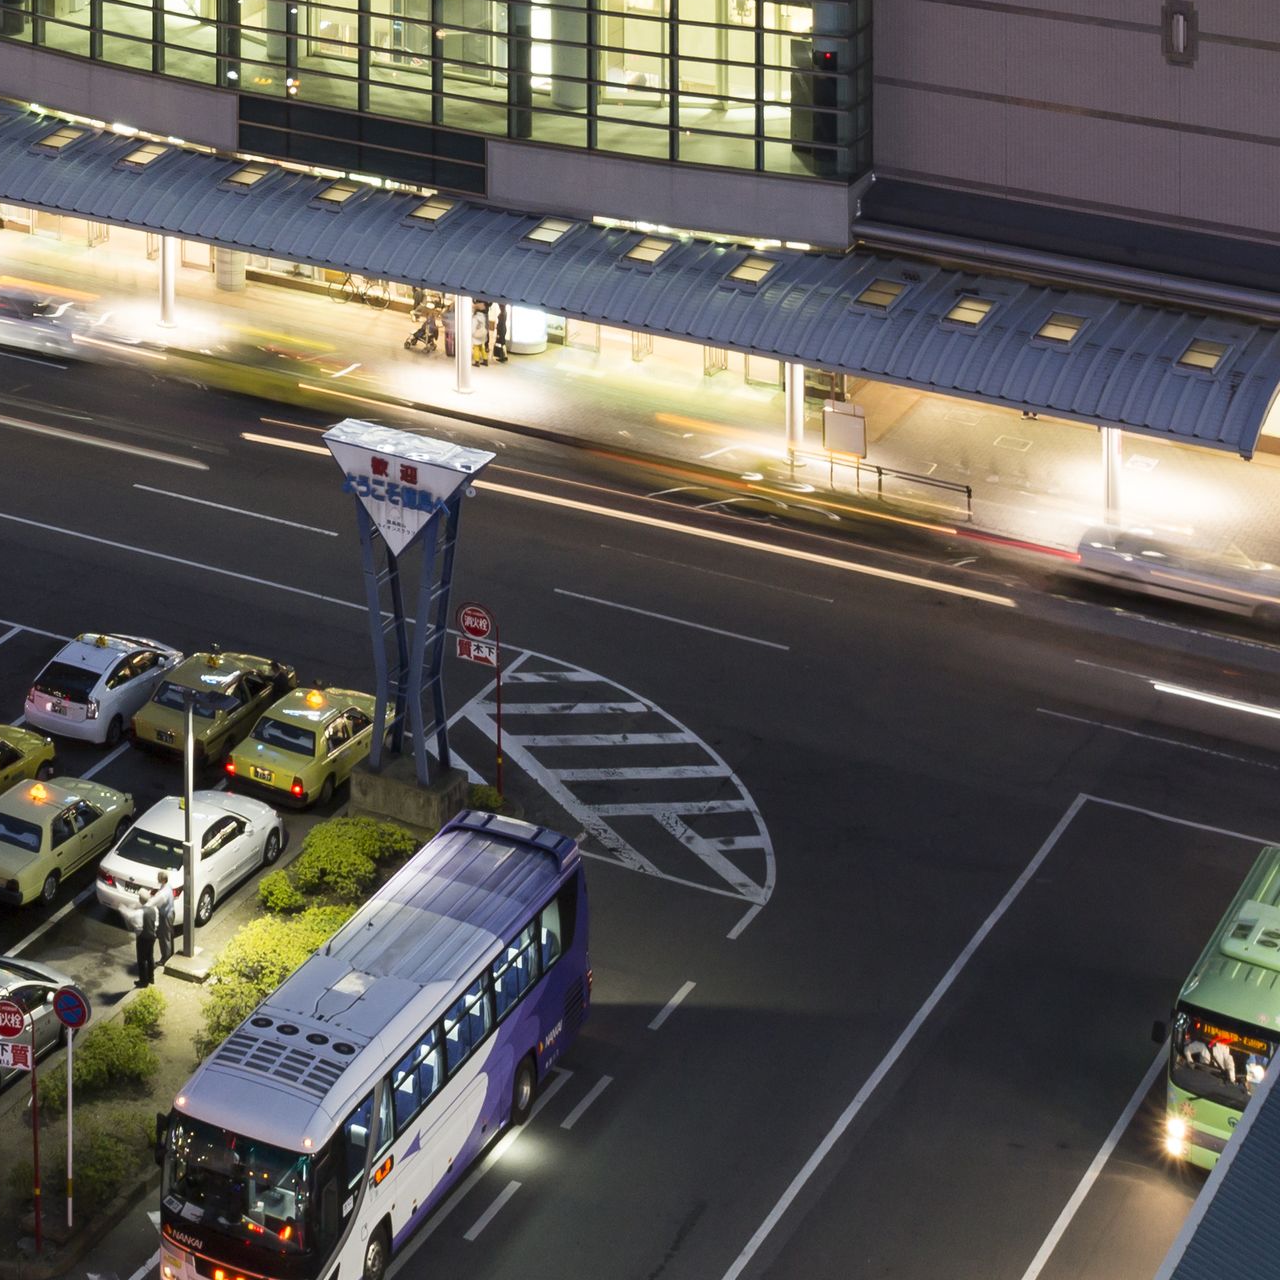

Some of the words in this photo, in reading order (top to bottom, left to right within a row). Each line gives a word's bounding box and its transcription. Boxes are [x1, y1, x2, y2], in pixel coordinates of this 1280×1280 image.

[370, 455, 419, 486] 歓迎
[463, 616, 489, 632] 消火栓
[473, 643, 496, 658] 木下
[11, 1044, 30, 1068] 質
[172, 1230, 205, 1250] NANKAI
